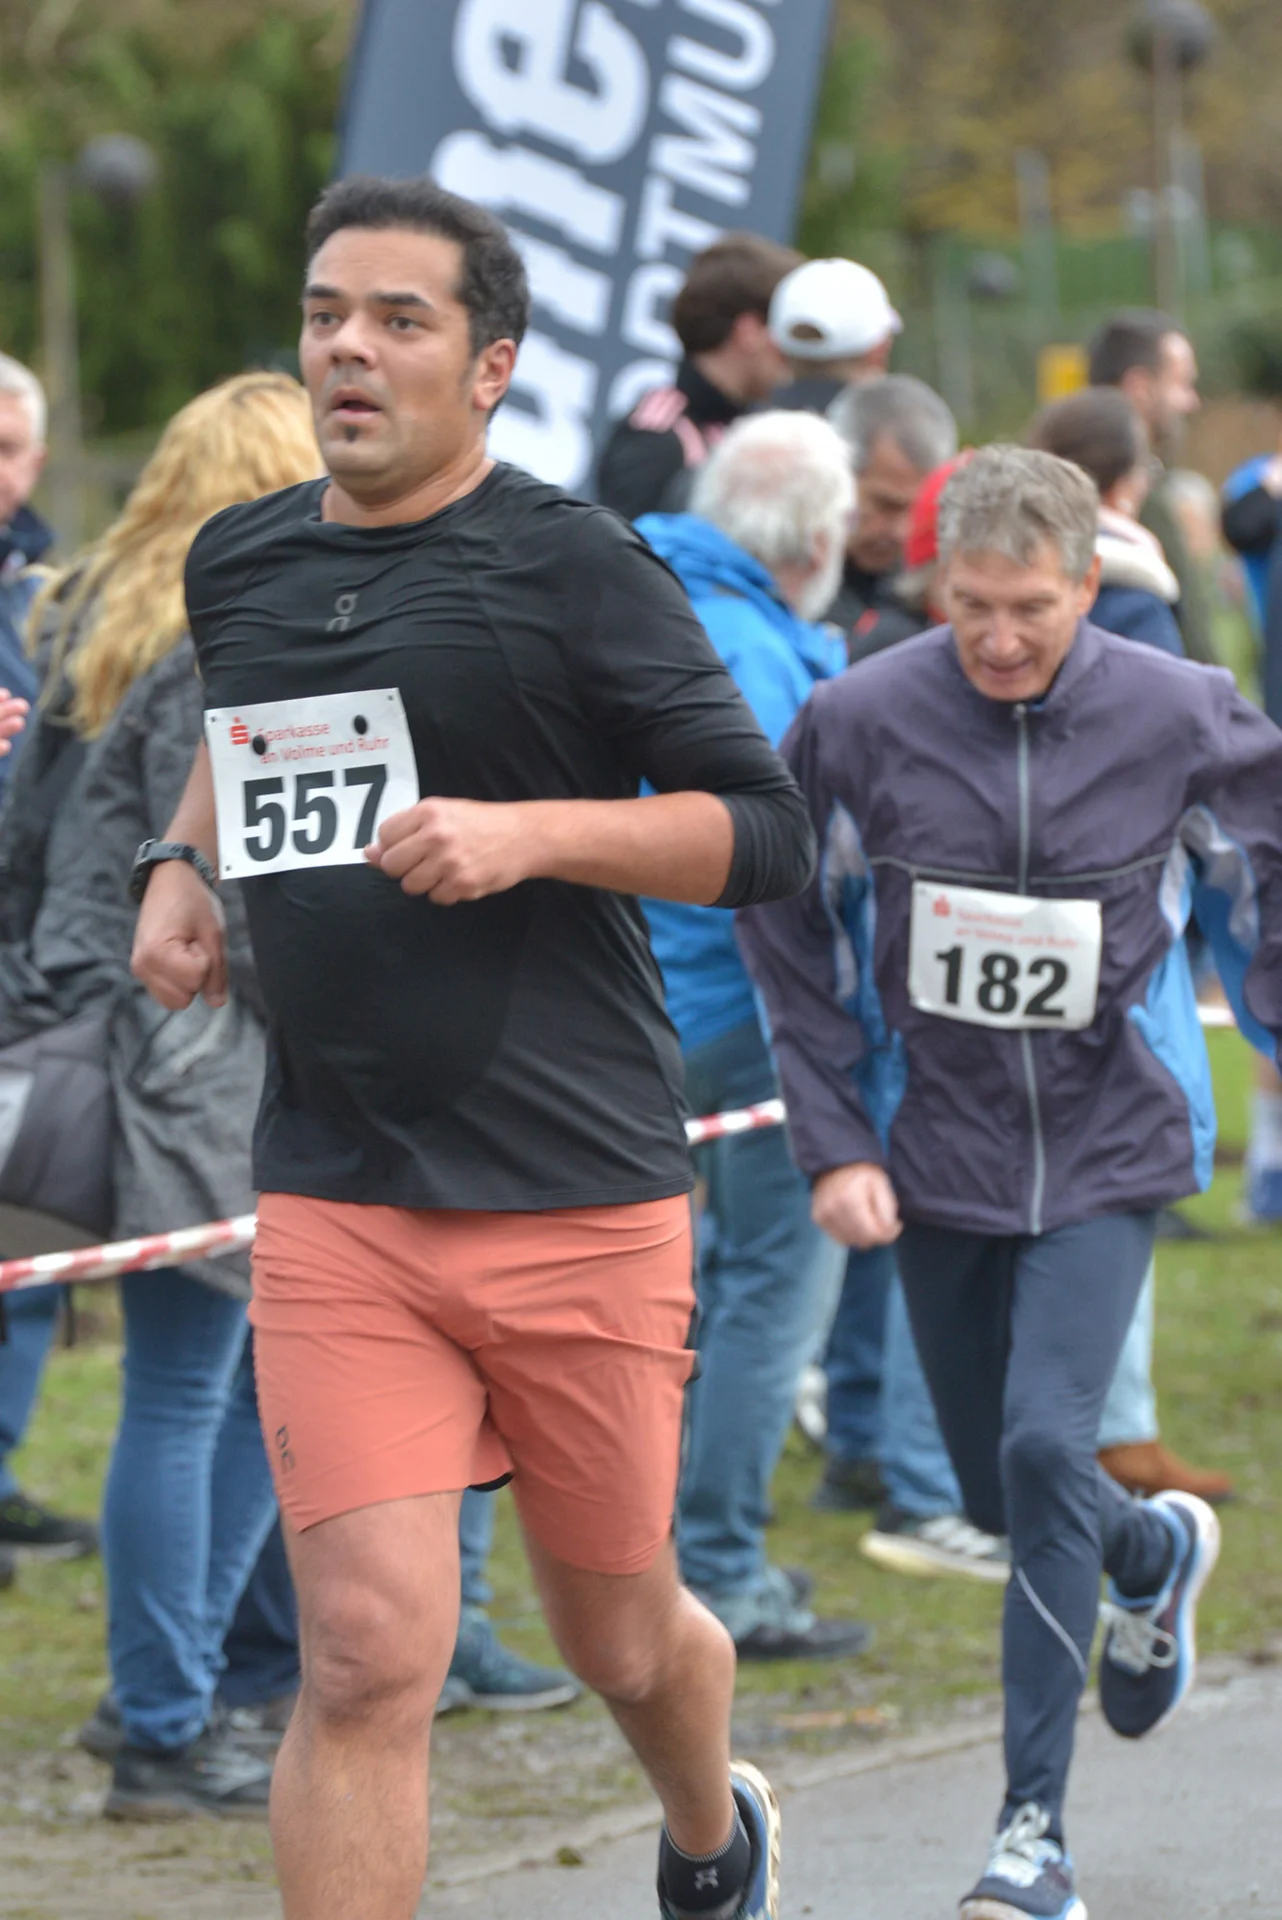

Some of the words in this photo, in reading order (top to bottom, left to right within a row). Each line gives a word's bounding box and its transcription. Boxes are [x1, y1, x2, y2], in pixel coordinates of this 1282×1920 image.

[280, 744, 326, 761] Volme
[330, 741, 355, 756] und
[357, 736, 390, 752] Ruhr
[242, 763, 388, 862] 557
[935, 944, 1069, 1019] 182
